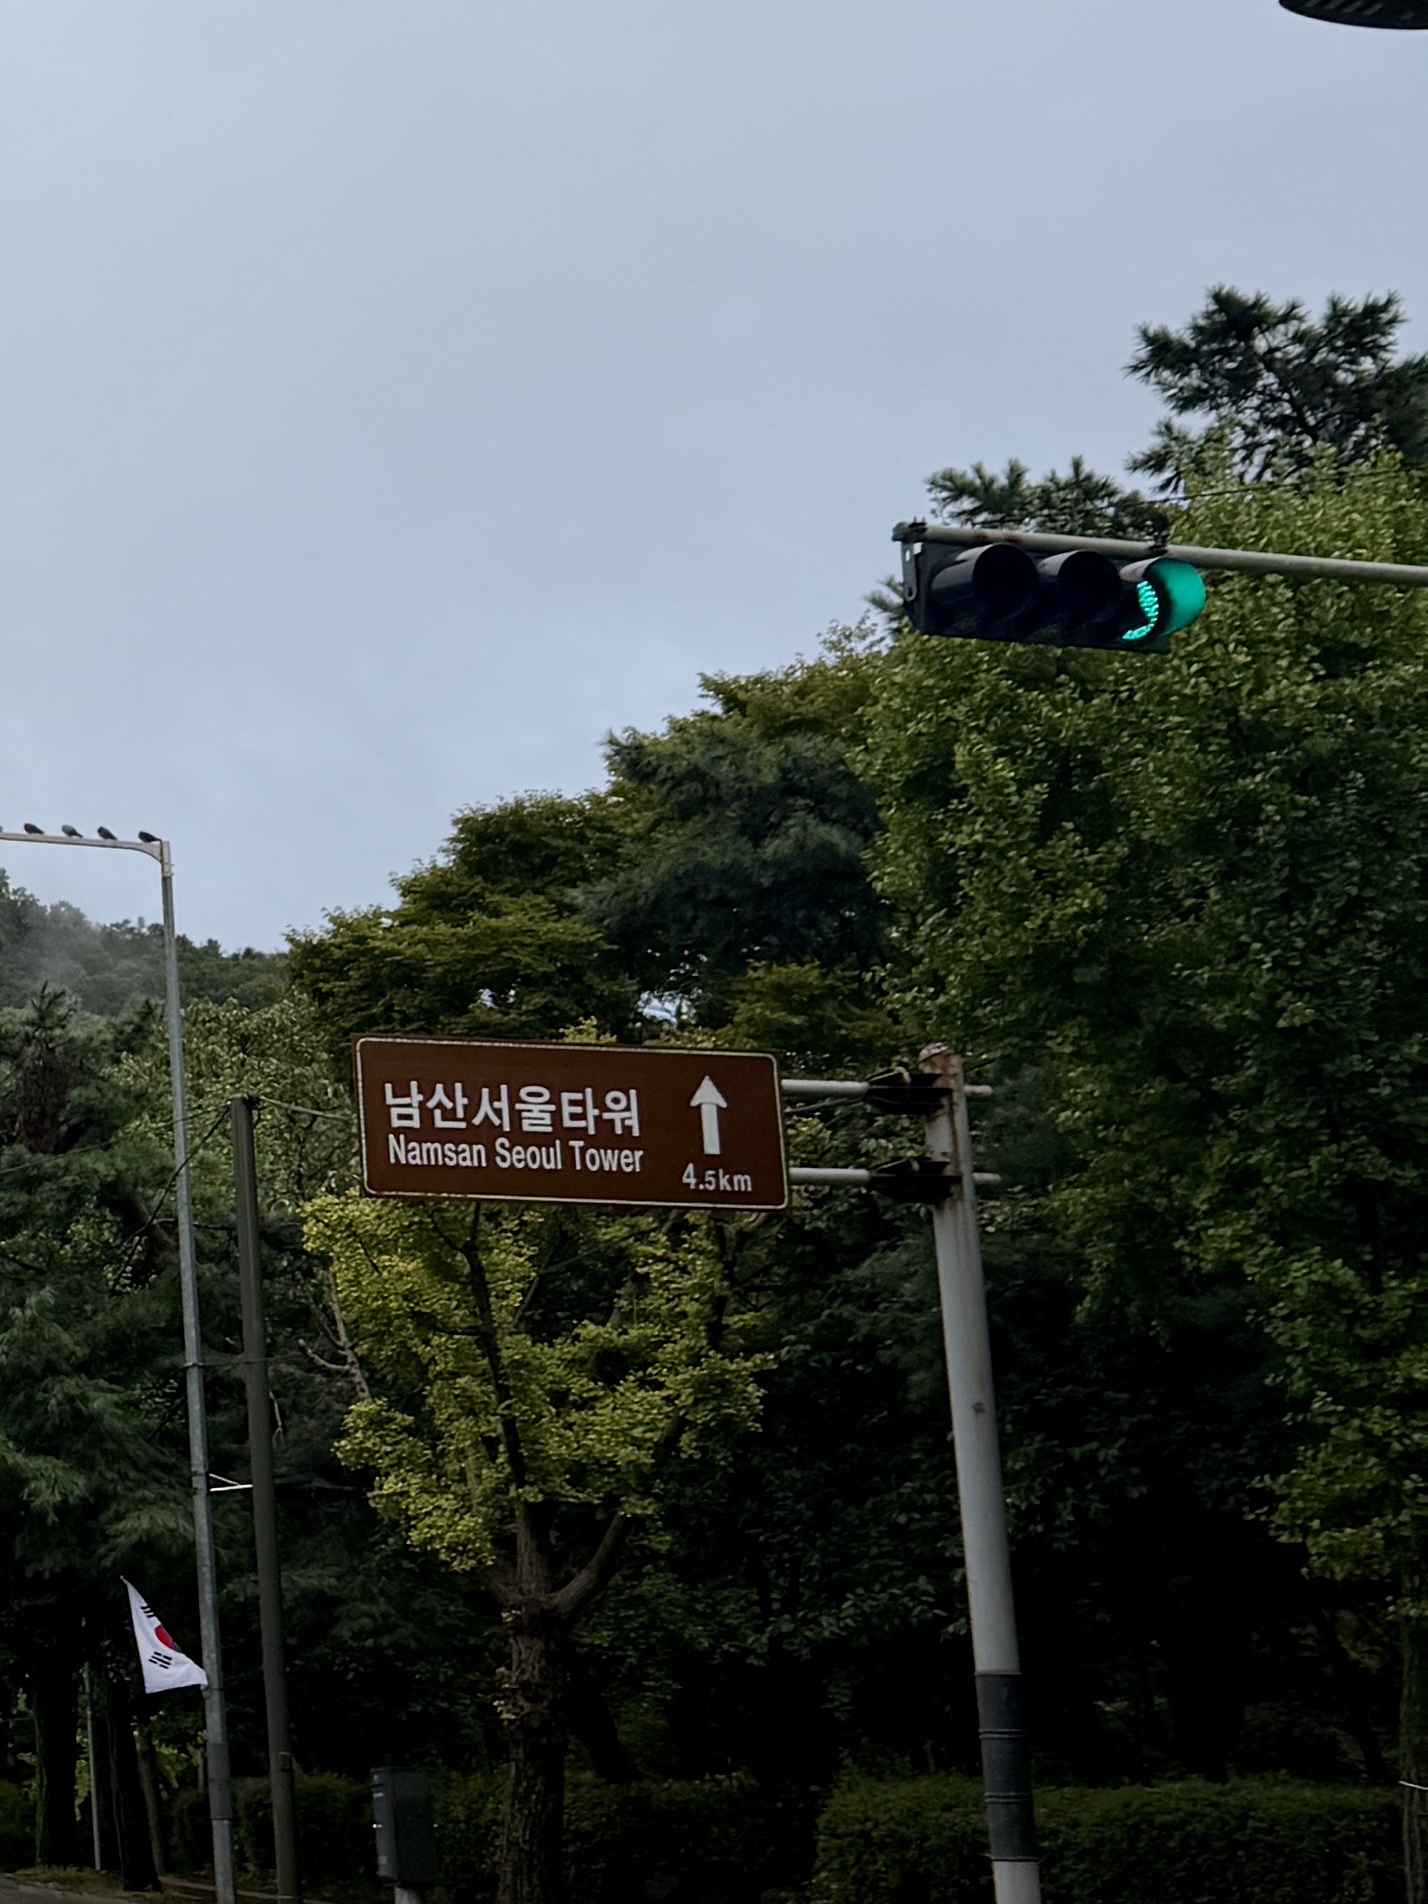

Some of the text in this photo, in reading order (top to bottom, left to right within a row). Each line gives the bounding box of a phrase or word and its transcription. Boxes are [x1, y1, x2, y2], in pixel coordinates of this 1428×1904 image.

[384, 1080, 641, 1137] 남산서울타워
[388, 1133, 644, 1173] Namsan Seoul Tower
[682, 1162, 753, 1192] 4.5km
